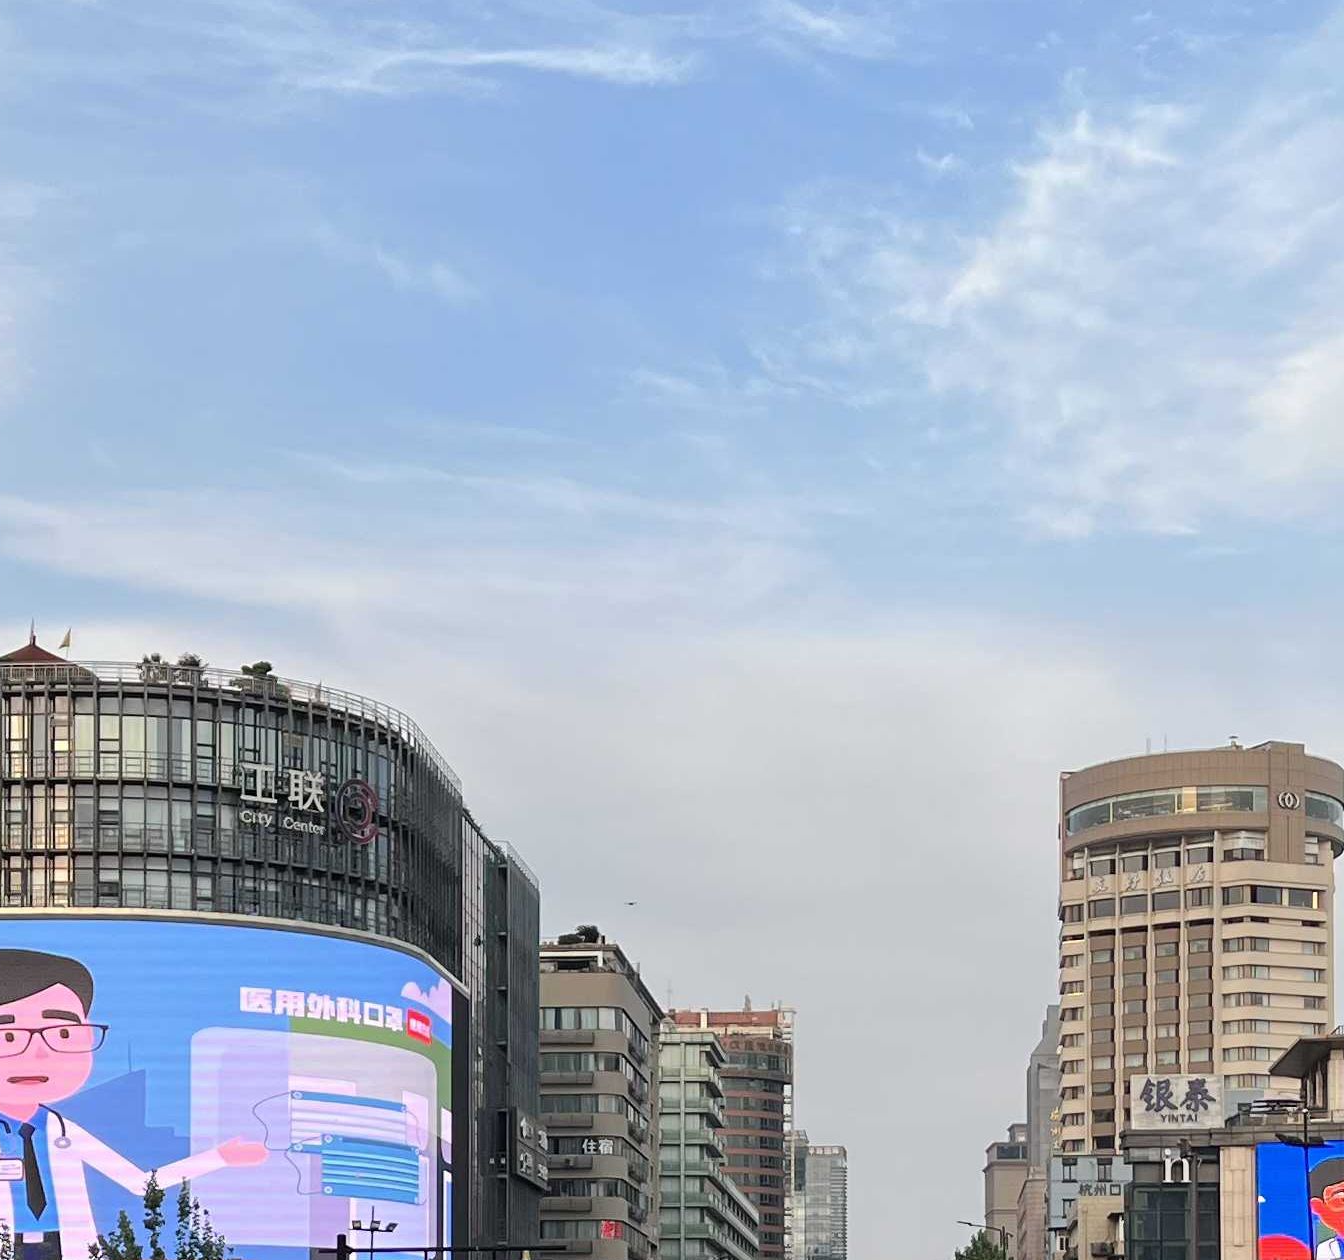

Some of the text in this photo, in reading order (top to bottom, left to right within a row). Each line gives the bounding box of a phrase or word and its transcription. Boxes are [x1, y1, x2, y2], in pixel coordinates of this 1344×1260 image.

[241, 809, 325, 836] City Center
[239, 986, 404, 1032] 医用外科口罩
[1140, 1077, 1216, 1112] 银泰
[1161, 1113, 1197, 1123] YINTAI
[582, 1138, 613, 1155] 住宿
